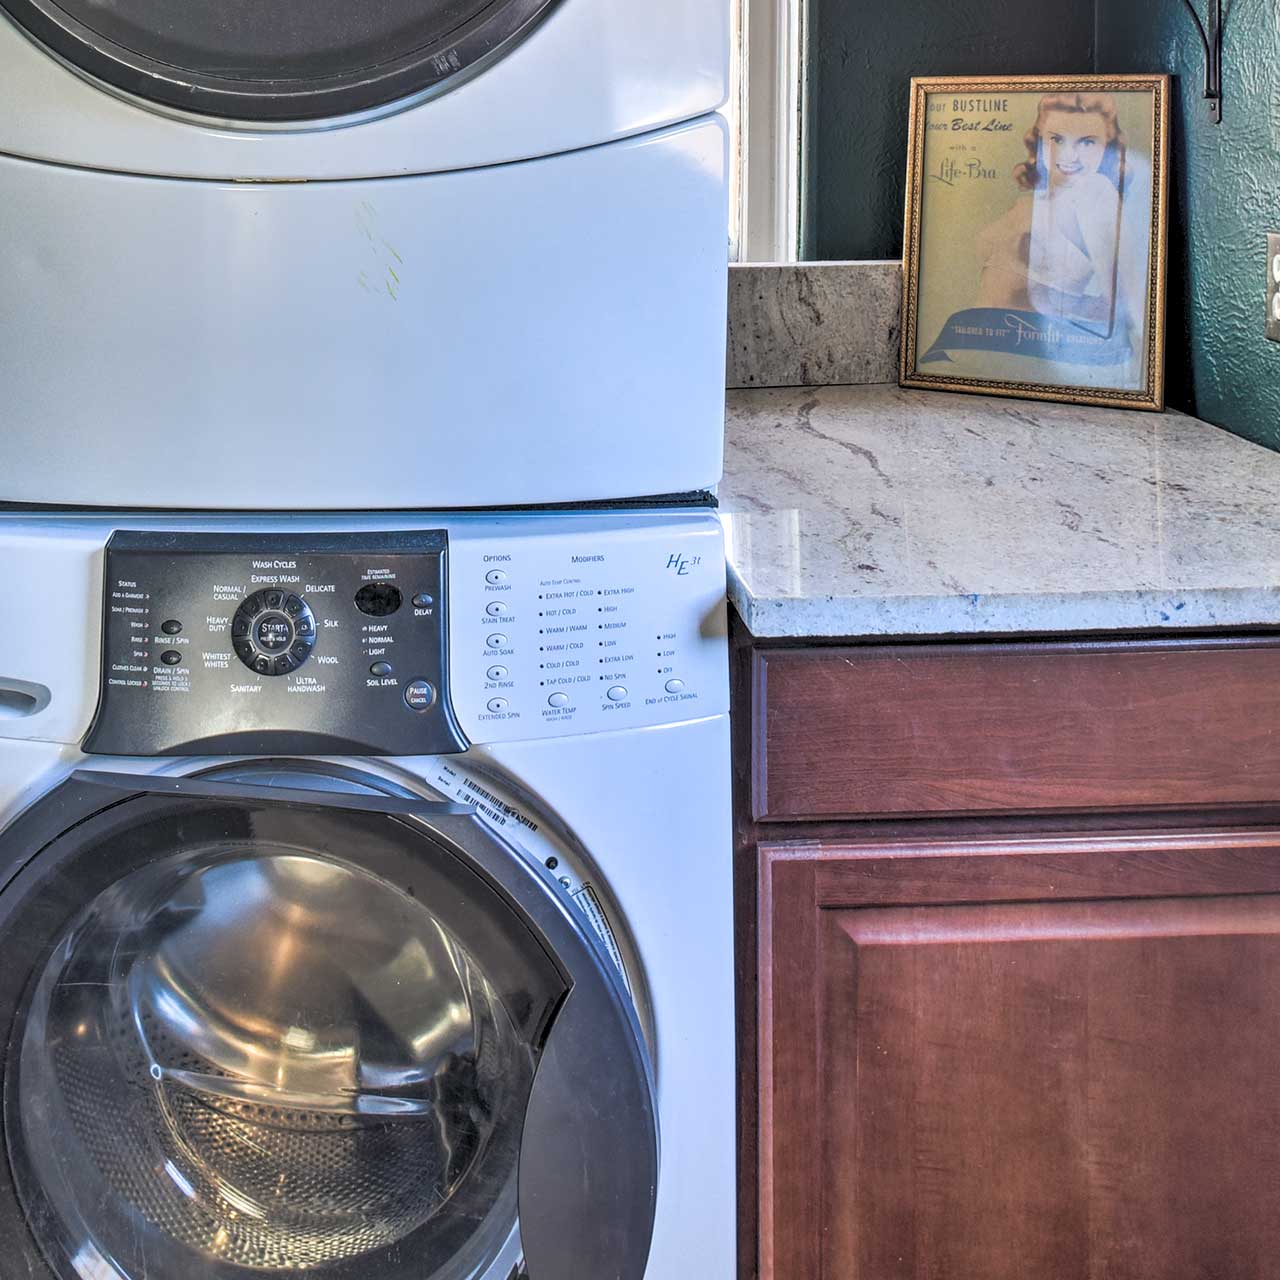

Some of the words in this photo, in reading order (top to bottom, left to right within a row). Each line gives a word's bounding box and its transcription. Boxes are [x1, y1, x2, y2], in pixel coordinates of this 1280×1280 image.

[952, 99, 1008, 112] BUSTLINE
[951, 117, 980, 131] Best
[982, 118, 1013, 132] Line
[928, 158, 996, 186] Life-Bra
[571, 555, 605, 563] MODIFIERS
[213, 585, 242, 593] NORMAL
[324, 619, 338, 627] SILK
[202, 652, 231, 660] WHITEST
[317, 656, 339, 664] WOOL
[230, 684, 262, 692] SANITARY
[542, 708, 561, 716] WATER
